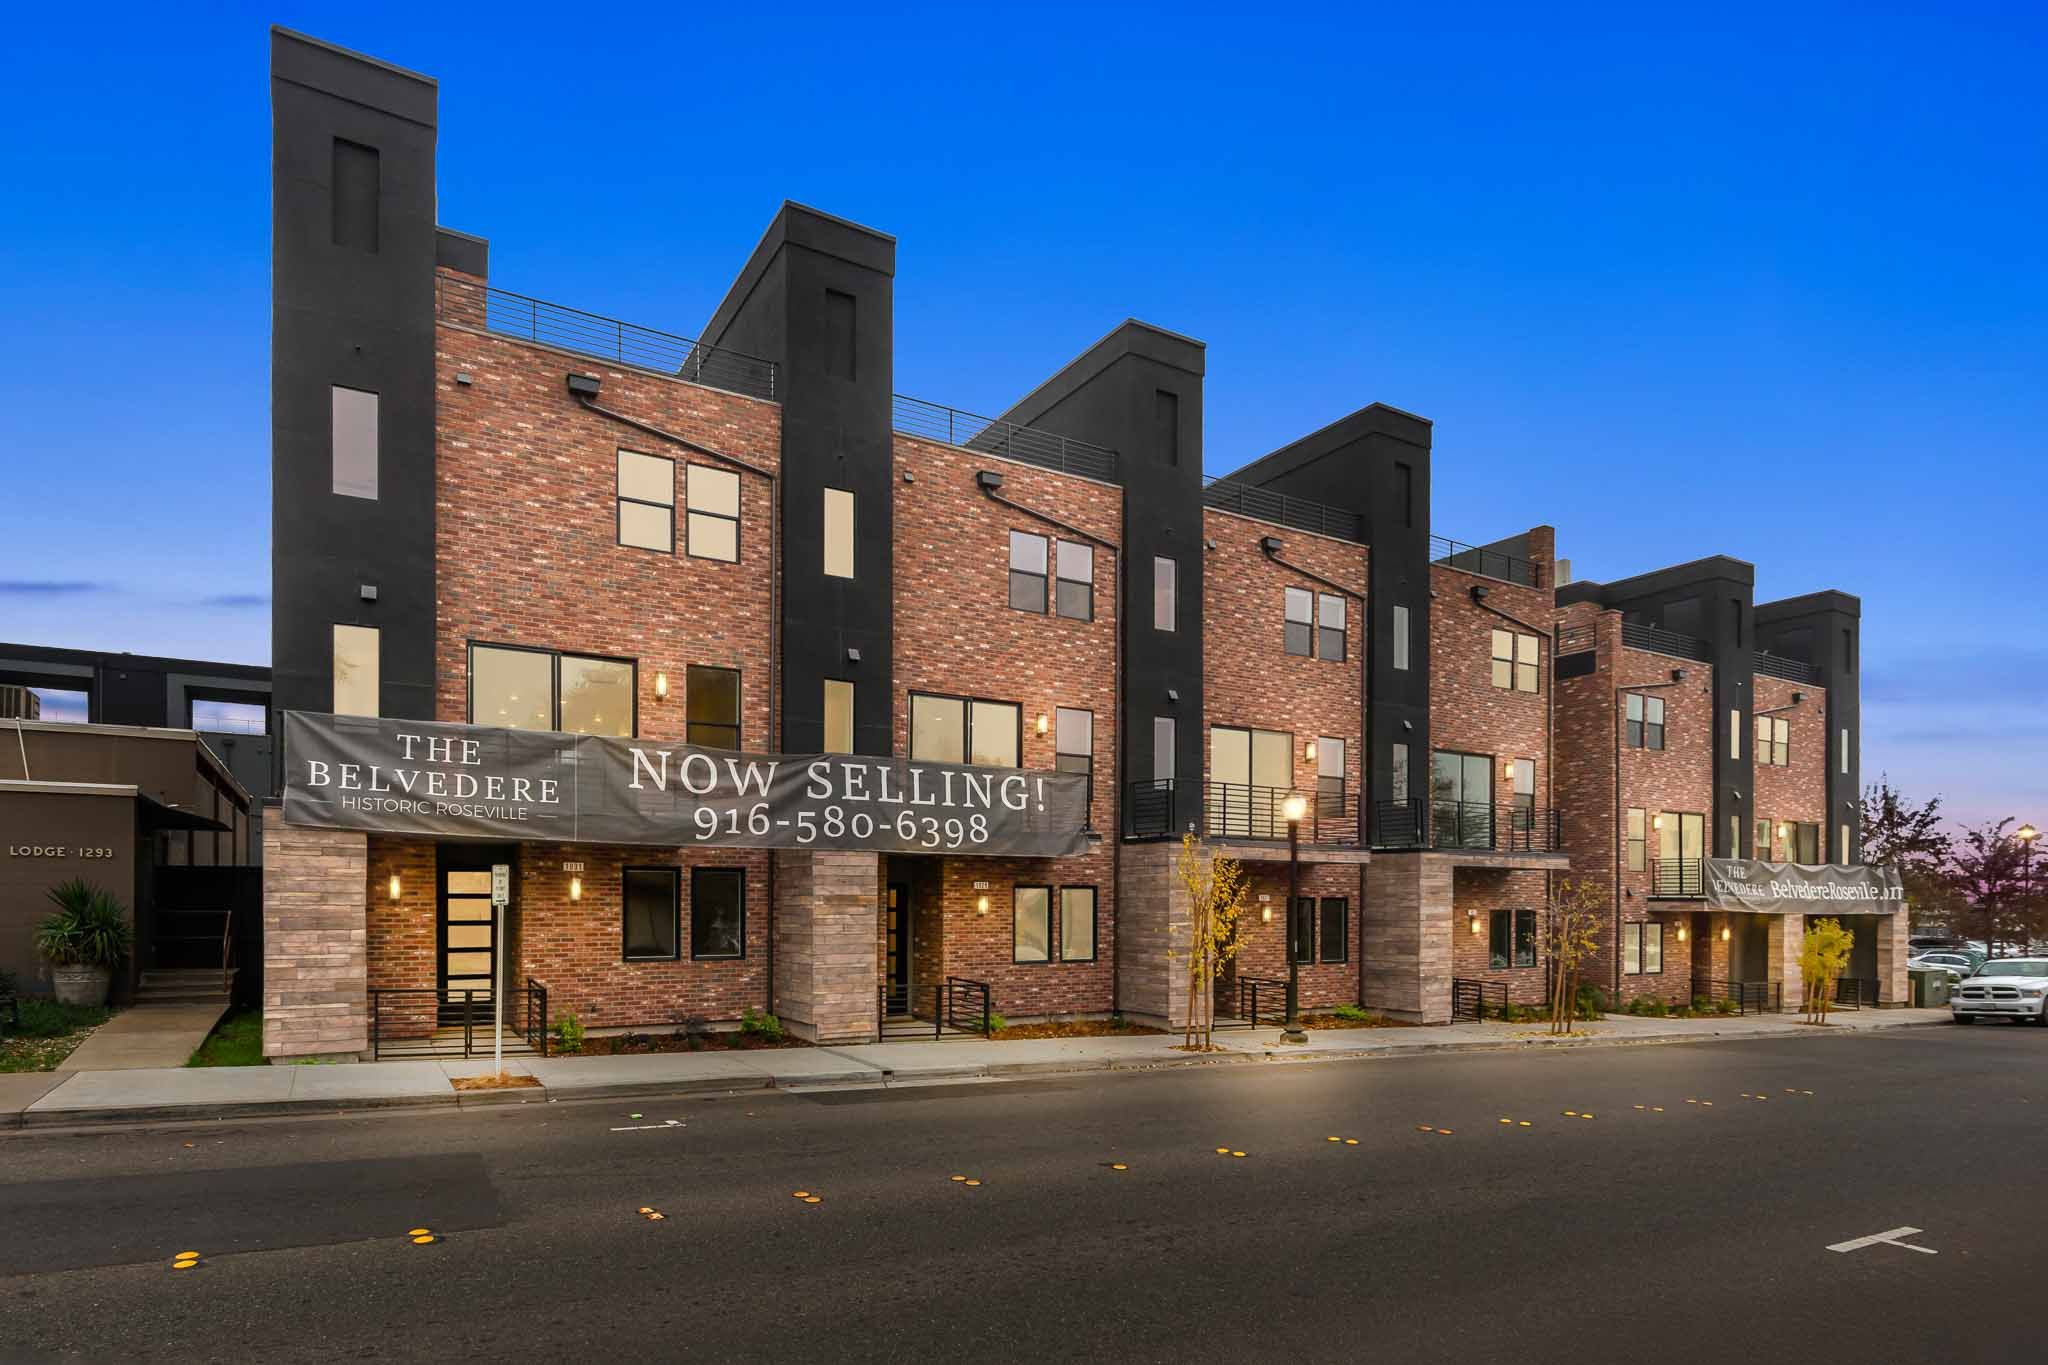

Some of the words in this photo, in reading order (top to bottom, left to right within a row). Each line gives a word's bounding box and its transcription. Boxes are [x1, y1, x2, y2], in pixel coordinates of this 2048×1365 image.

[397, 734, 481, 765] THE
[307, 760, 560, 803] BELVEDERE
[628, 748, 779, 797] NOW
[807, 762, 1045, 812] SELLING!
[342, 795, 431, 815] HISTORIC
[436, 802, 529, 821] ROSEVILLE
[694, 802, 990, 849] 916-580-6398
[9, 845, 66, 857] LODGE
[79, 847, 113, 858] 1293
[1727, 865, 1747, 879] THE
